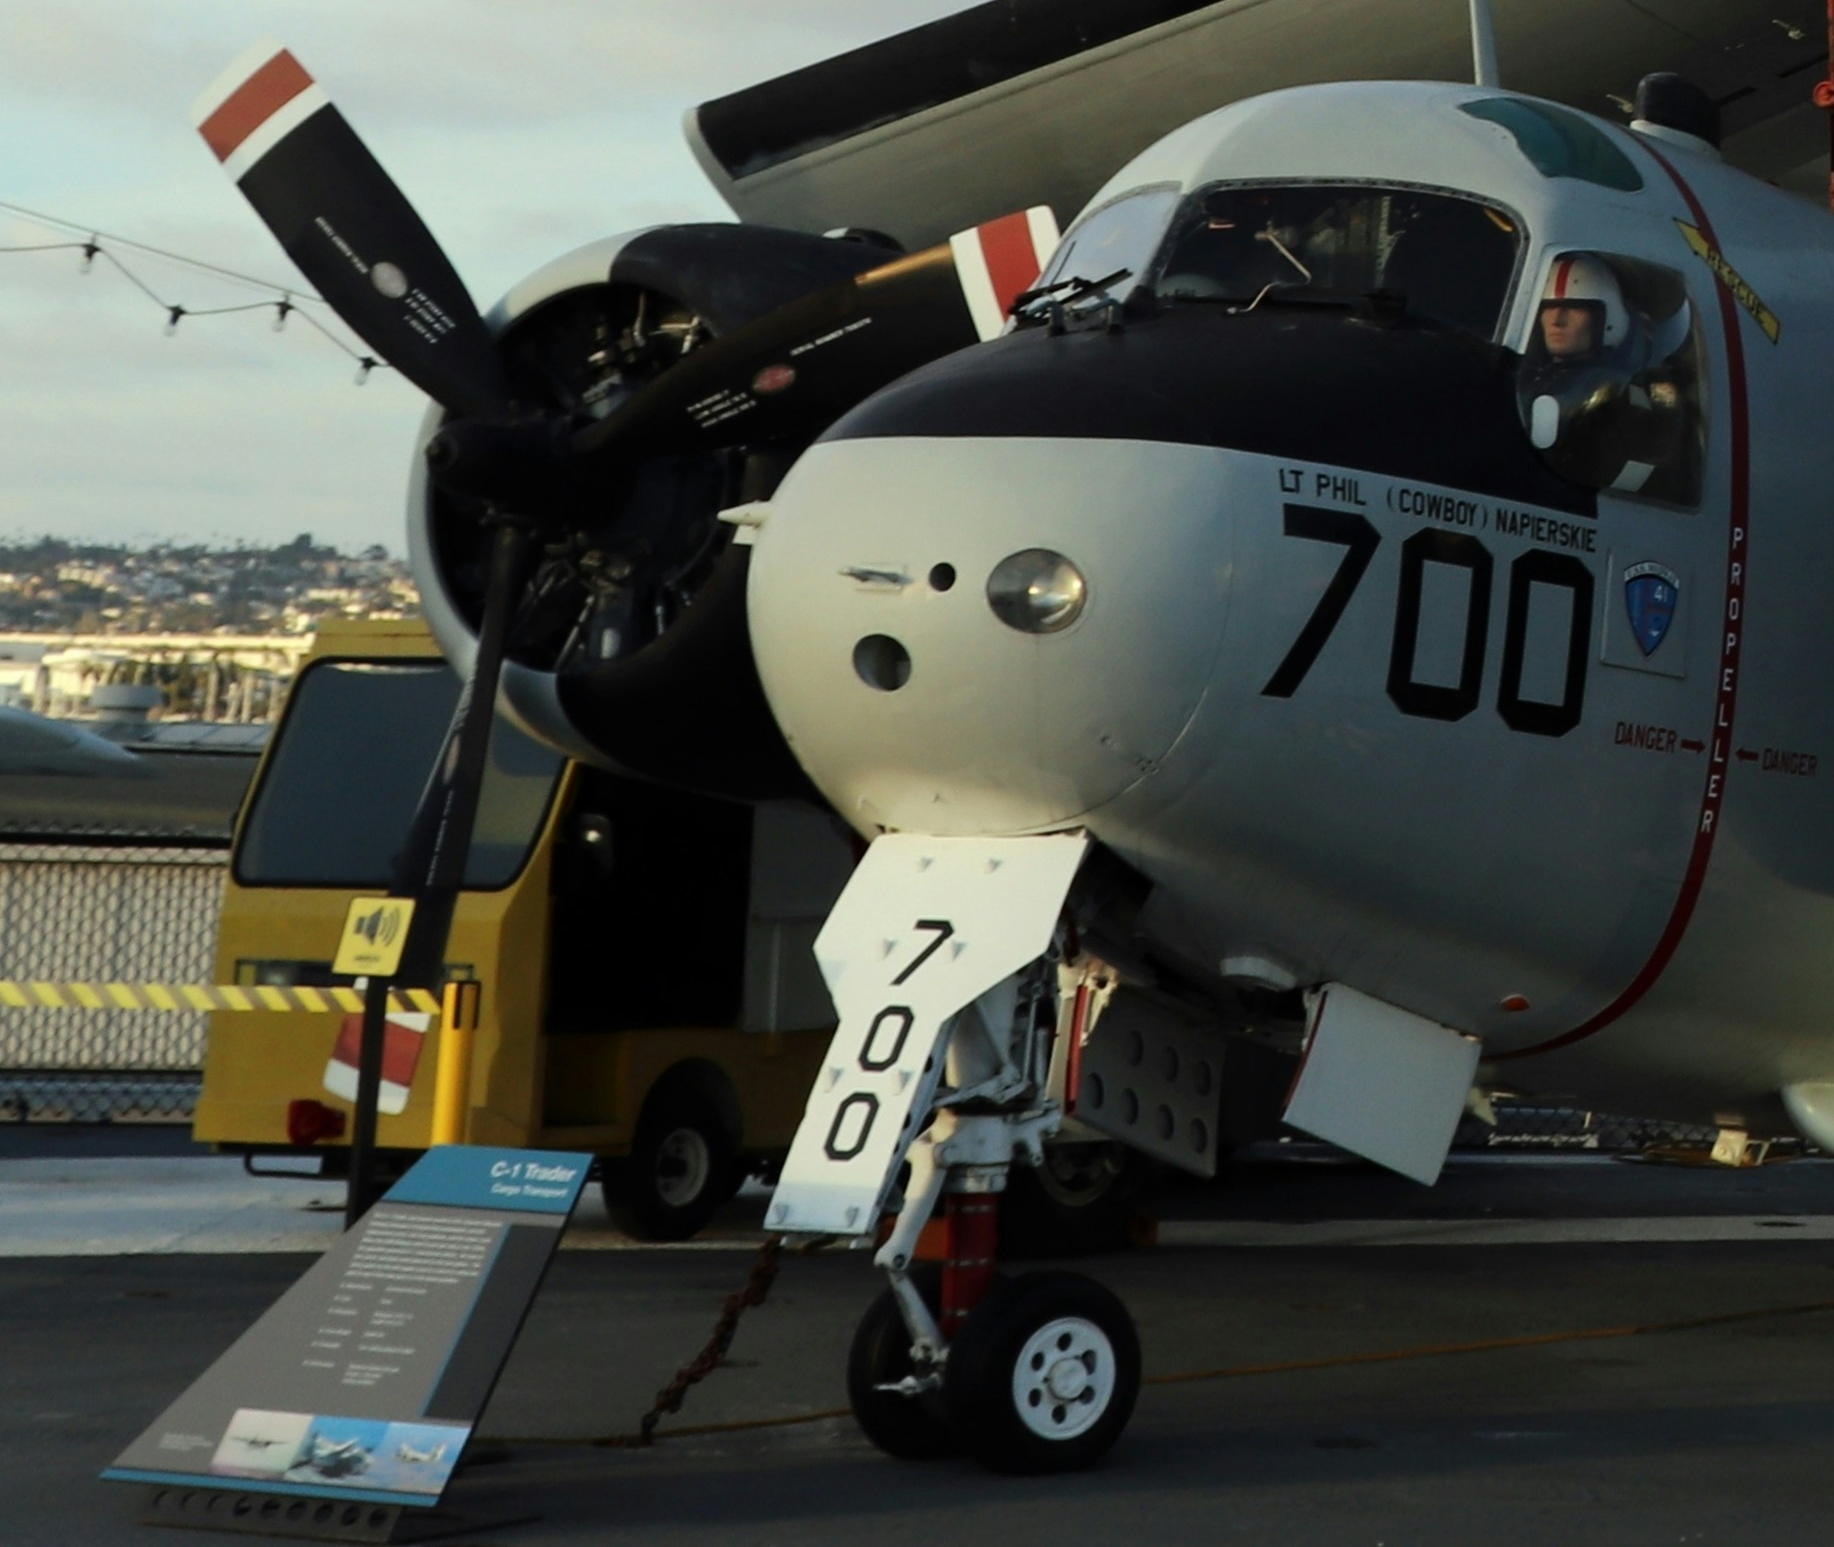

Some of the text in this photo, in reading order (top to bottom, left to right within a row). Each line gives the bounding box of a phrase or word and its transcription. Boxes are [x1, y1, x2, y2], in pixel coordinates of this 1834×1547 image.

[1279, 468, 1304, 493] LT
[1316, 473, 1366, 506] PHIL
[1495, 508, 1597, 553] NAPIERSKIE
[1261, 503, 1595, 737] 700
[1701, 527, 1743, 832] PROPELLER
[1614, 721, 1677, 754] DANGER
[1762, 748, 1818, 777] DANGER
[490, 1160, 577, 1182] C-1 Trader
